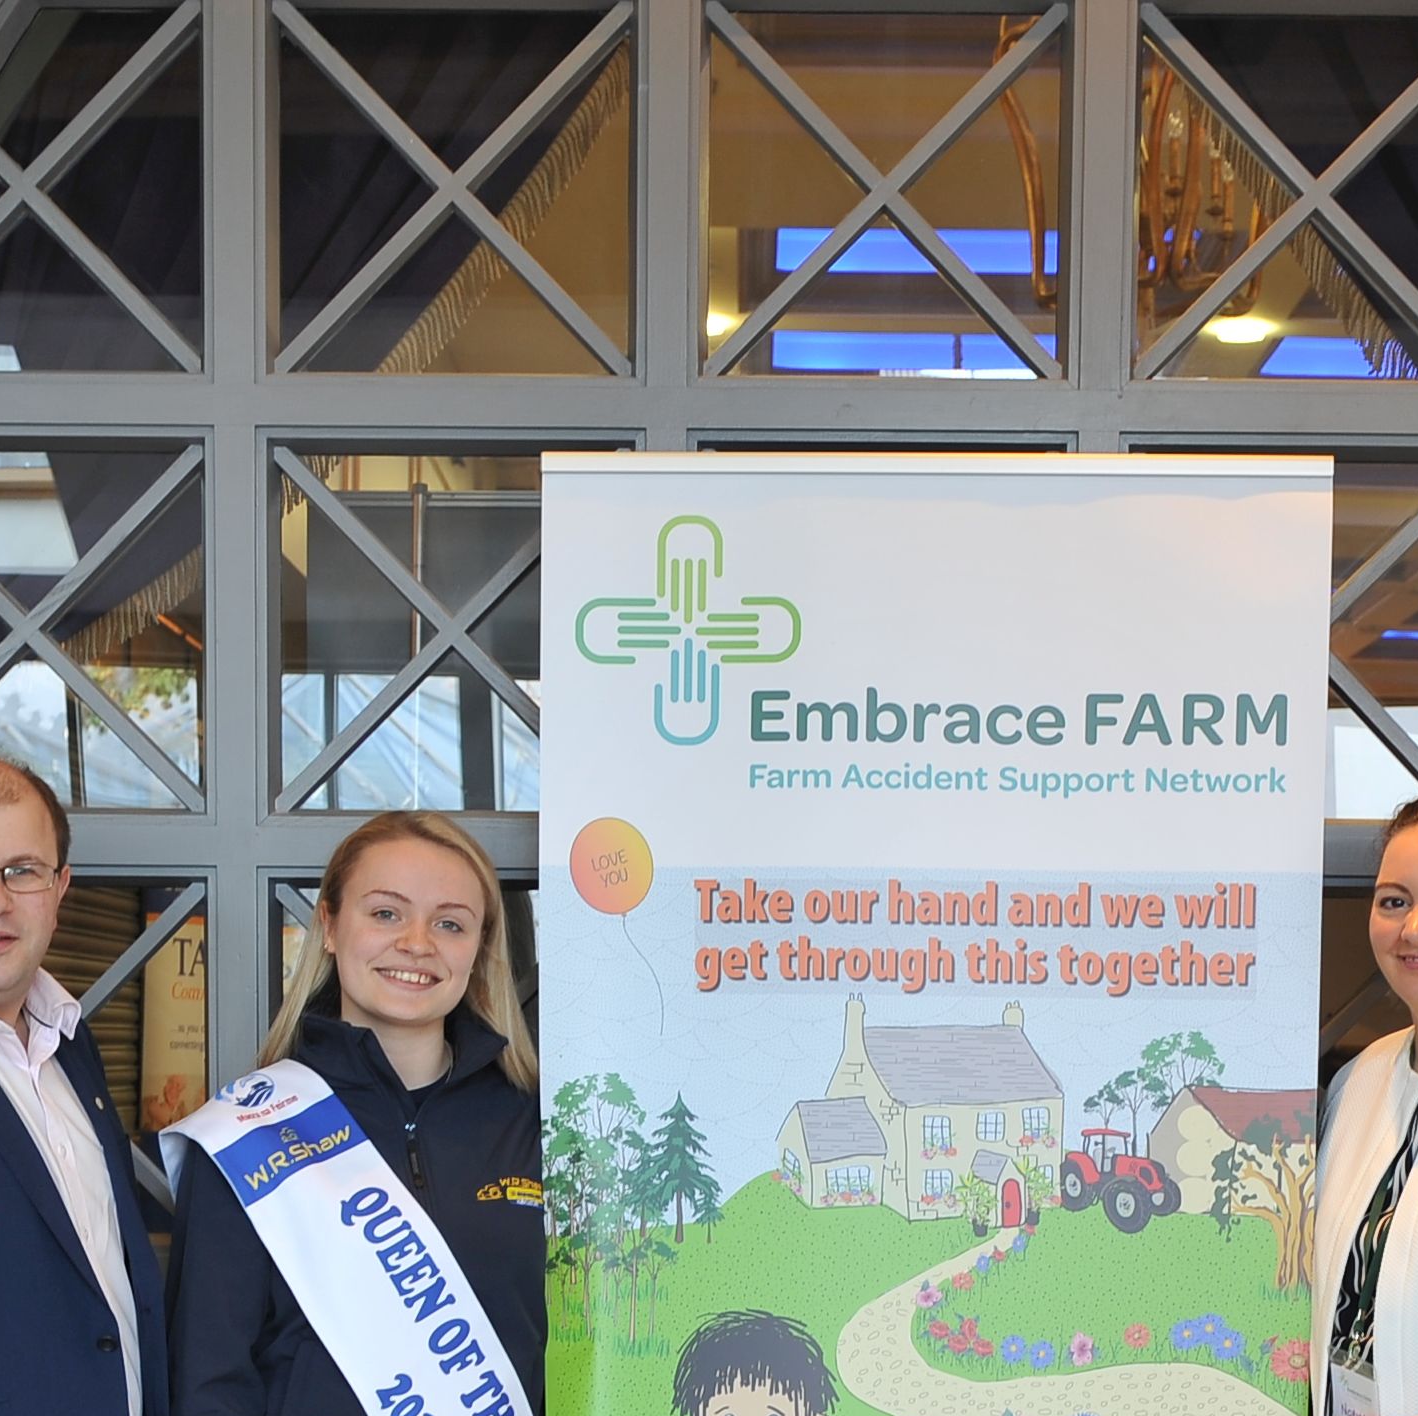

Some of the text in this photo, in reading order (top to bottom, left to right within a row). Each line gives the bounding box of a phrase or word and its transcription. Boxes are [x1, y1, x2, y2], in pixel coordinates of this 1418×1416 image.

[749, 686, 1289, 746] Embrace FARM
[749, 762, 1287, 799] Farm Accident Support Network
[591, 848, 628, 872] LOVE
[599, 867, 628, 888] YOU
[693, 878, 1257, 930] Take our hand and we will
[694, 936, 1255, 997] get through this together
[243, 1124, 351, 1191] W.R.Shaw
[340, 1187, 456, 1322] QUEEN
[428, 1318, 486, 1375] OF
